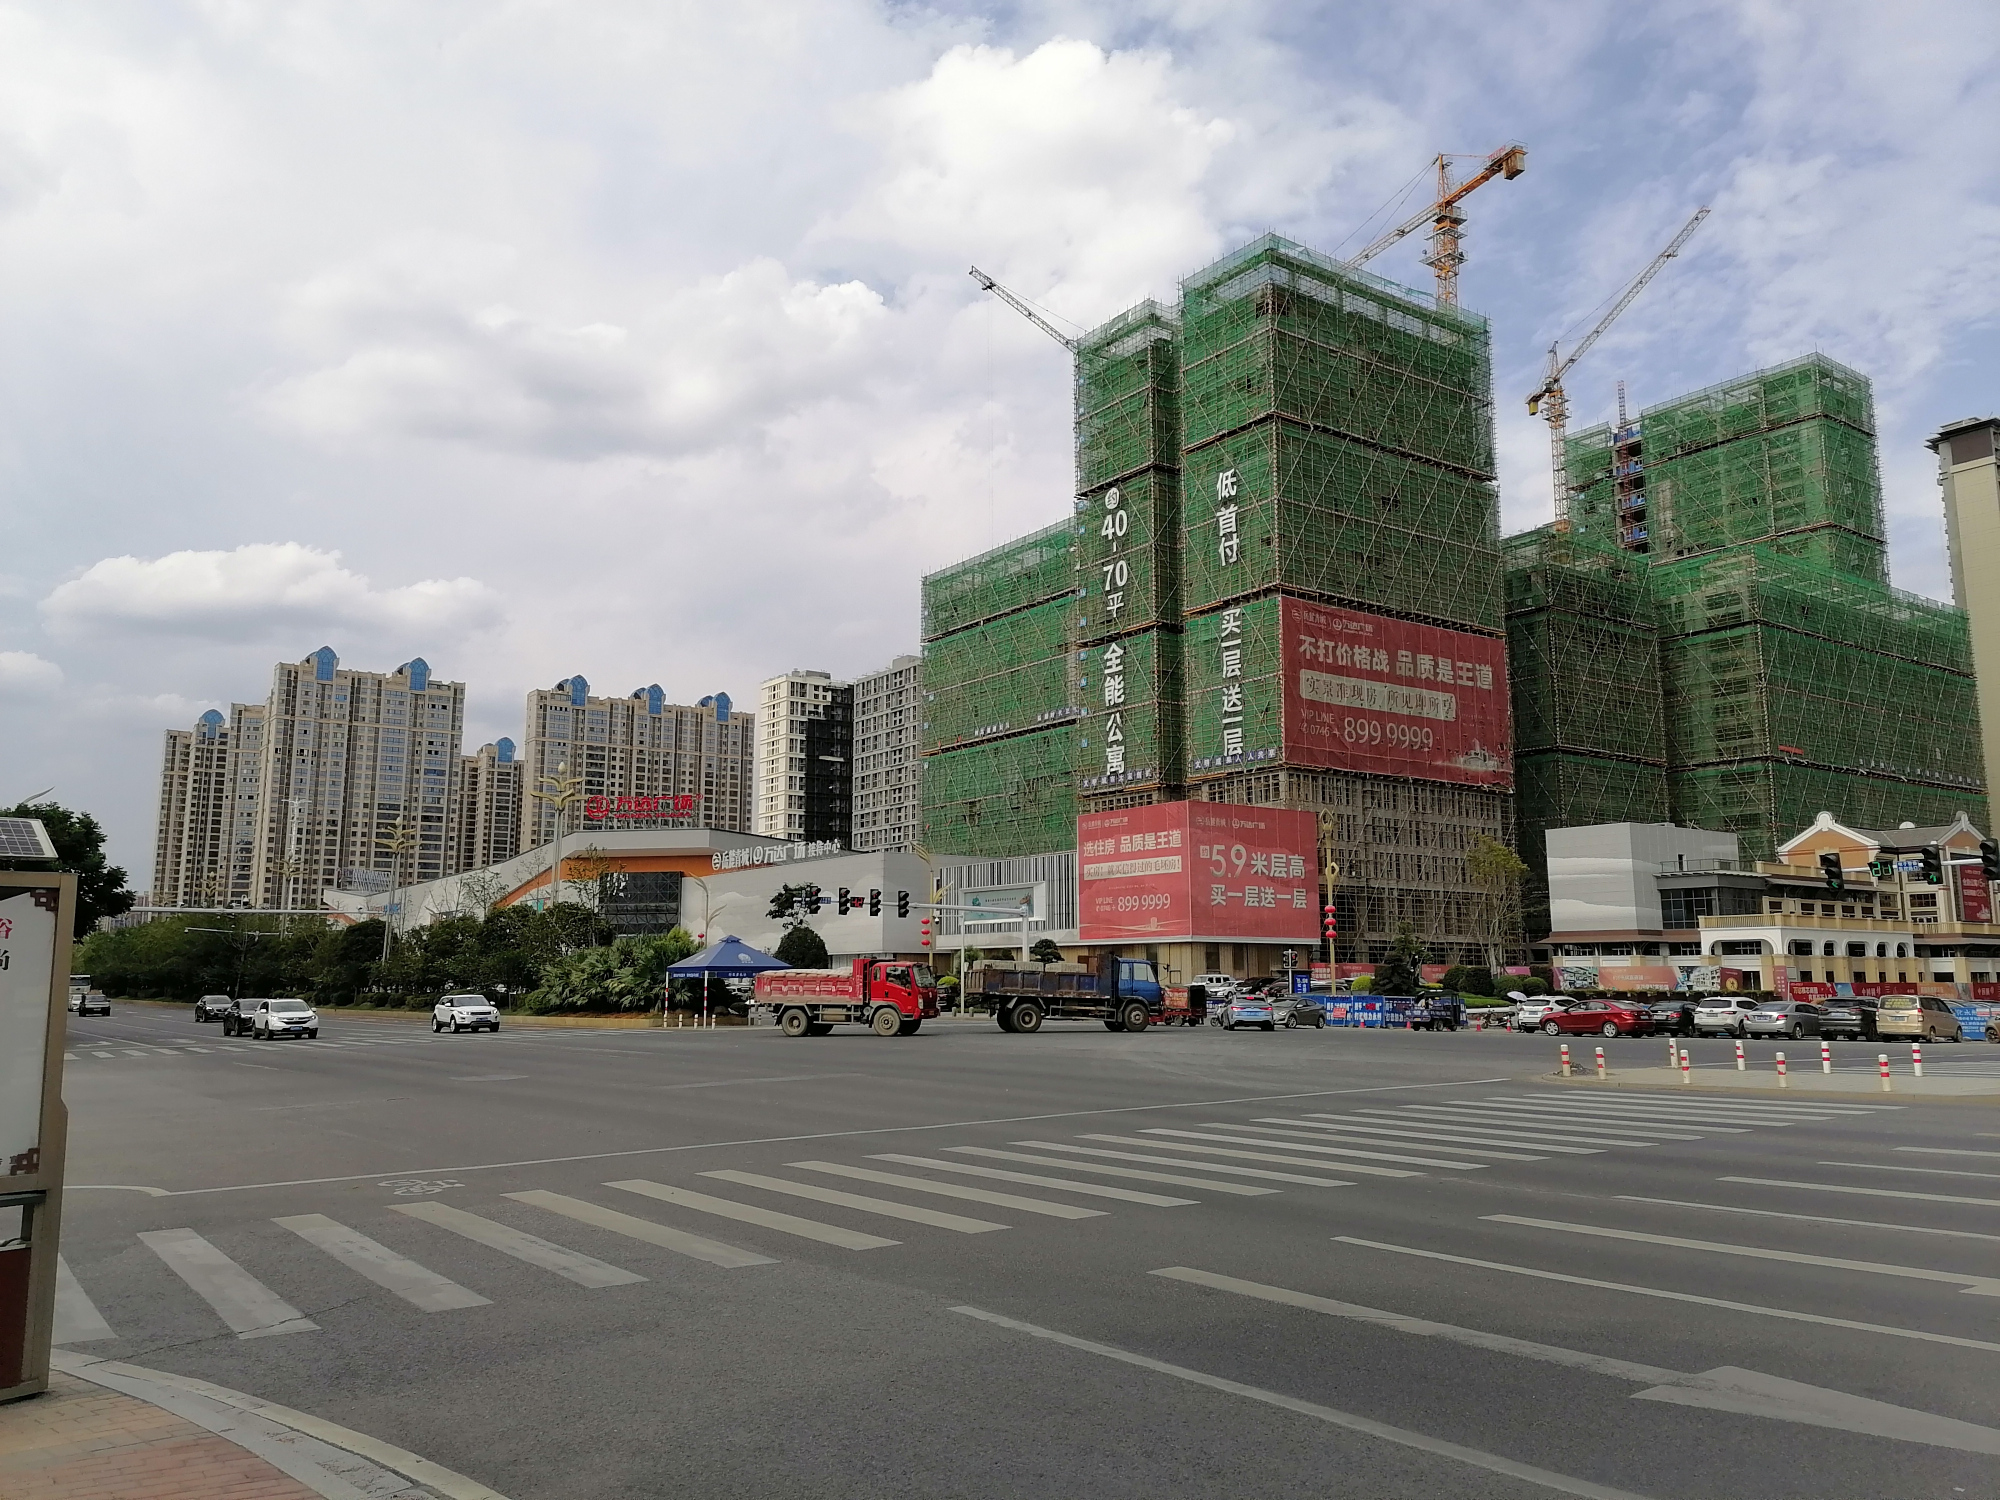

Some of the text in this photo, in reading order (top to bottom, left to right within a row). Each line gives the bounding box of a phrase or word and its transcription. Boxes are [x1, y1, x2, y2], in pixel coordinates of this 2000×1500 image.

[1216, 467, 1239, 567] 低首付
[1298, 635, 1493, 690] 不打价格战 品质是王道
[1221, 606, 1243, 757] 买一层送一层
[1103, 642, 1125, 775] 全能公寓
[1301, 708, 1335, 724] VIP LINE
[1310, 725, 1330, 737] 0746
[1344, 717, 1381, 745] 899
[1386, 722, 1433, 751] 9999
[615, 795, 693, 811] 万达广场
[764, 842, 806, 863] 万达广场
[808, 839, 840, 857] 接待中心
[1084, 829, 1182, 857] 选住房 品质是王道
[1118, 896, 1139, 912] 899
[1141, 893, 1171, 910] 9999
[1211, 884, 1307, 909] 买一层送一层
